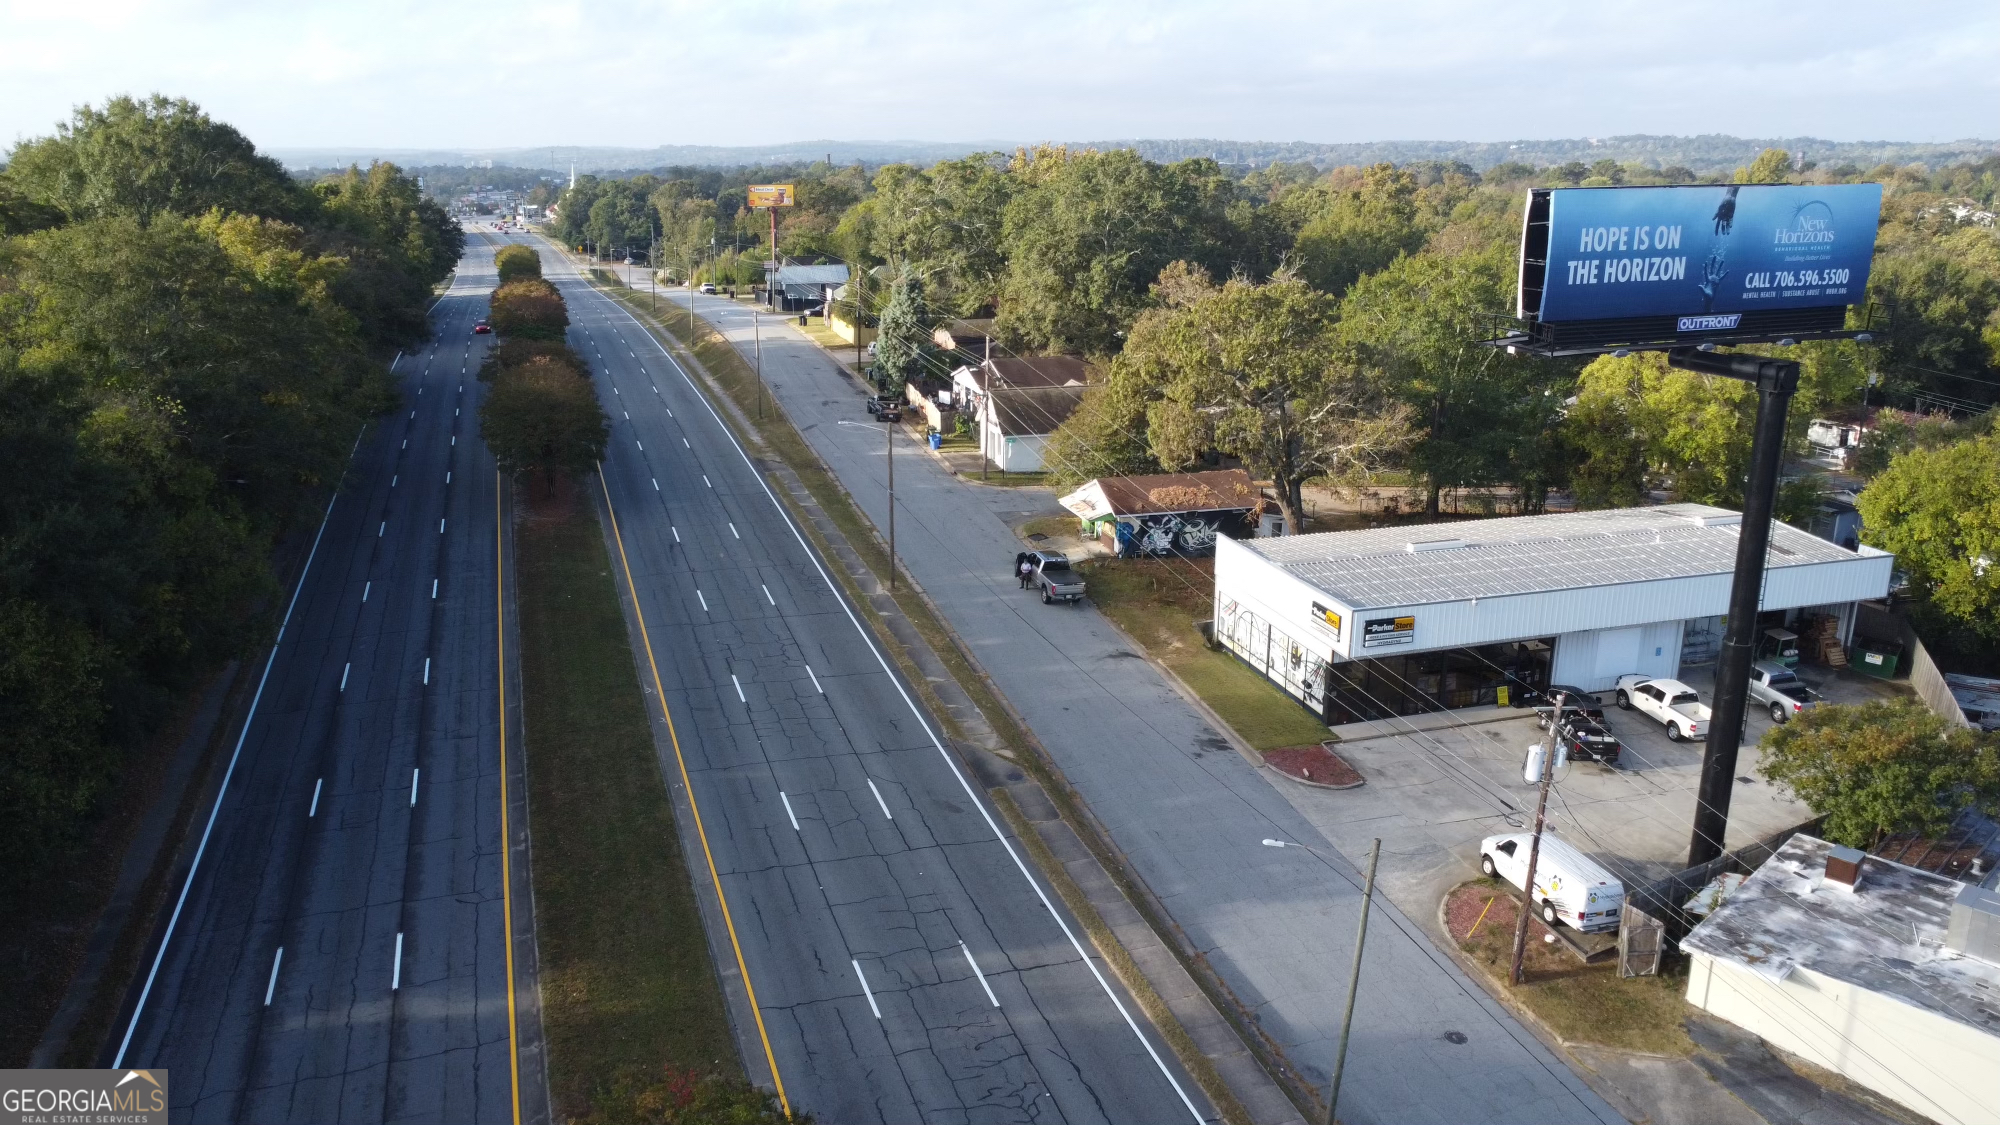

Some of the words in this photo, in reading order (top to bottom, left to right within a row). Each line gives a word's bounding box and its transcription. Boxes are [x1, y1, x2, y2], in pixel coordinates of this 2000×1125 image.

[1797, 215, 1828, 231] New
[1580, 227, 1629, 252] HOPE
[1633, 226, 1650, 250] IS
[1654, 225, 1681, 250] ON
[1773, 228, 1835, 244] Horizons
[1567, 259, 1600, 285] THE
[1603, 256, 1686, 283] HORIZON
[1745, 272, 1771, 288] CALL
[1773, 268, 1850, 287] 706.596.5500
[1782, 289, 1806, 298] SUBSTANCE
[1806, 288, 1821, 296] ABUSE
[1680, 316, 1738, 329] OUTFRONT
